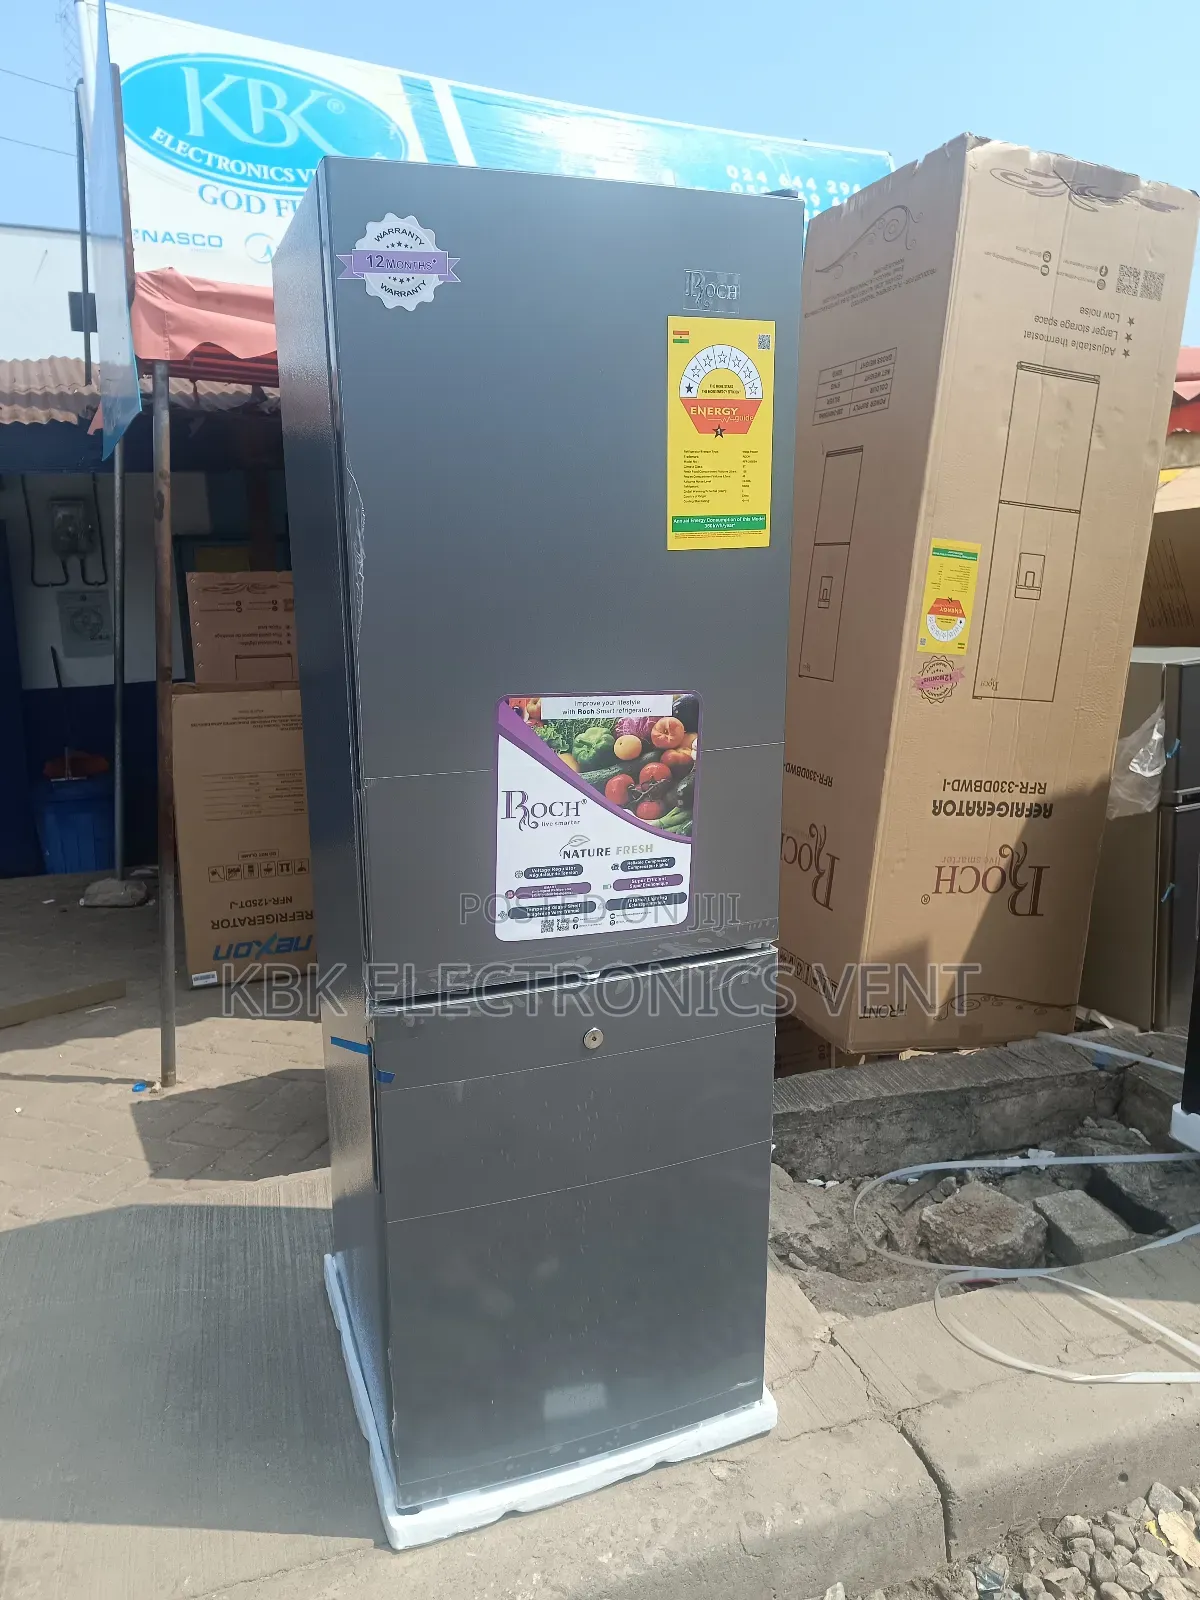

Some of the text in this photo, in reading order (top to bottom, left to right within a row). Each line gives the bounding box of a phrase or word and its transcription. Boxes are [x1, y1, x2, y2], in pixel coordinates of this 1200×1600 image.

[149, 126, 296, 183] ELECTRONICS
[726, 164, 767, 183] 024
[197, 184, 266, 216] GOD
[142, 229, 223, 248] NASCO
[374, 227, 425, 245] WARRANTY
[380, 280, 426, 297] WARRANTY
[1080, 307, 1120, 323] Low noise
[1034, 315, 1118, 340] Larger storage space
[1023, 330, 1116, 356] Adjustable thermostat
[690, 405, 739, 418] ENERGY
[932, 799, 1053, 819] REFRIGERATOR
[562, 844, 653, 859] NATURE FRESH
[941, 855, 981, 865] smarter
[781, 823, 840, 911] ROC
[210, 910, 314, 931] REFRIGERATOR
[859, 1003, 907, 1019] FRONT
